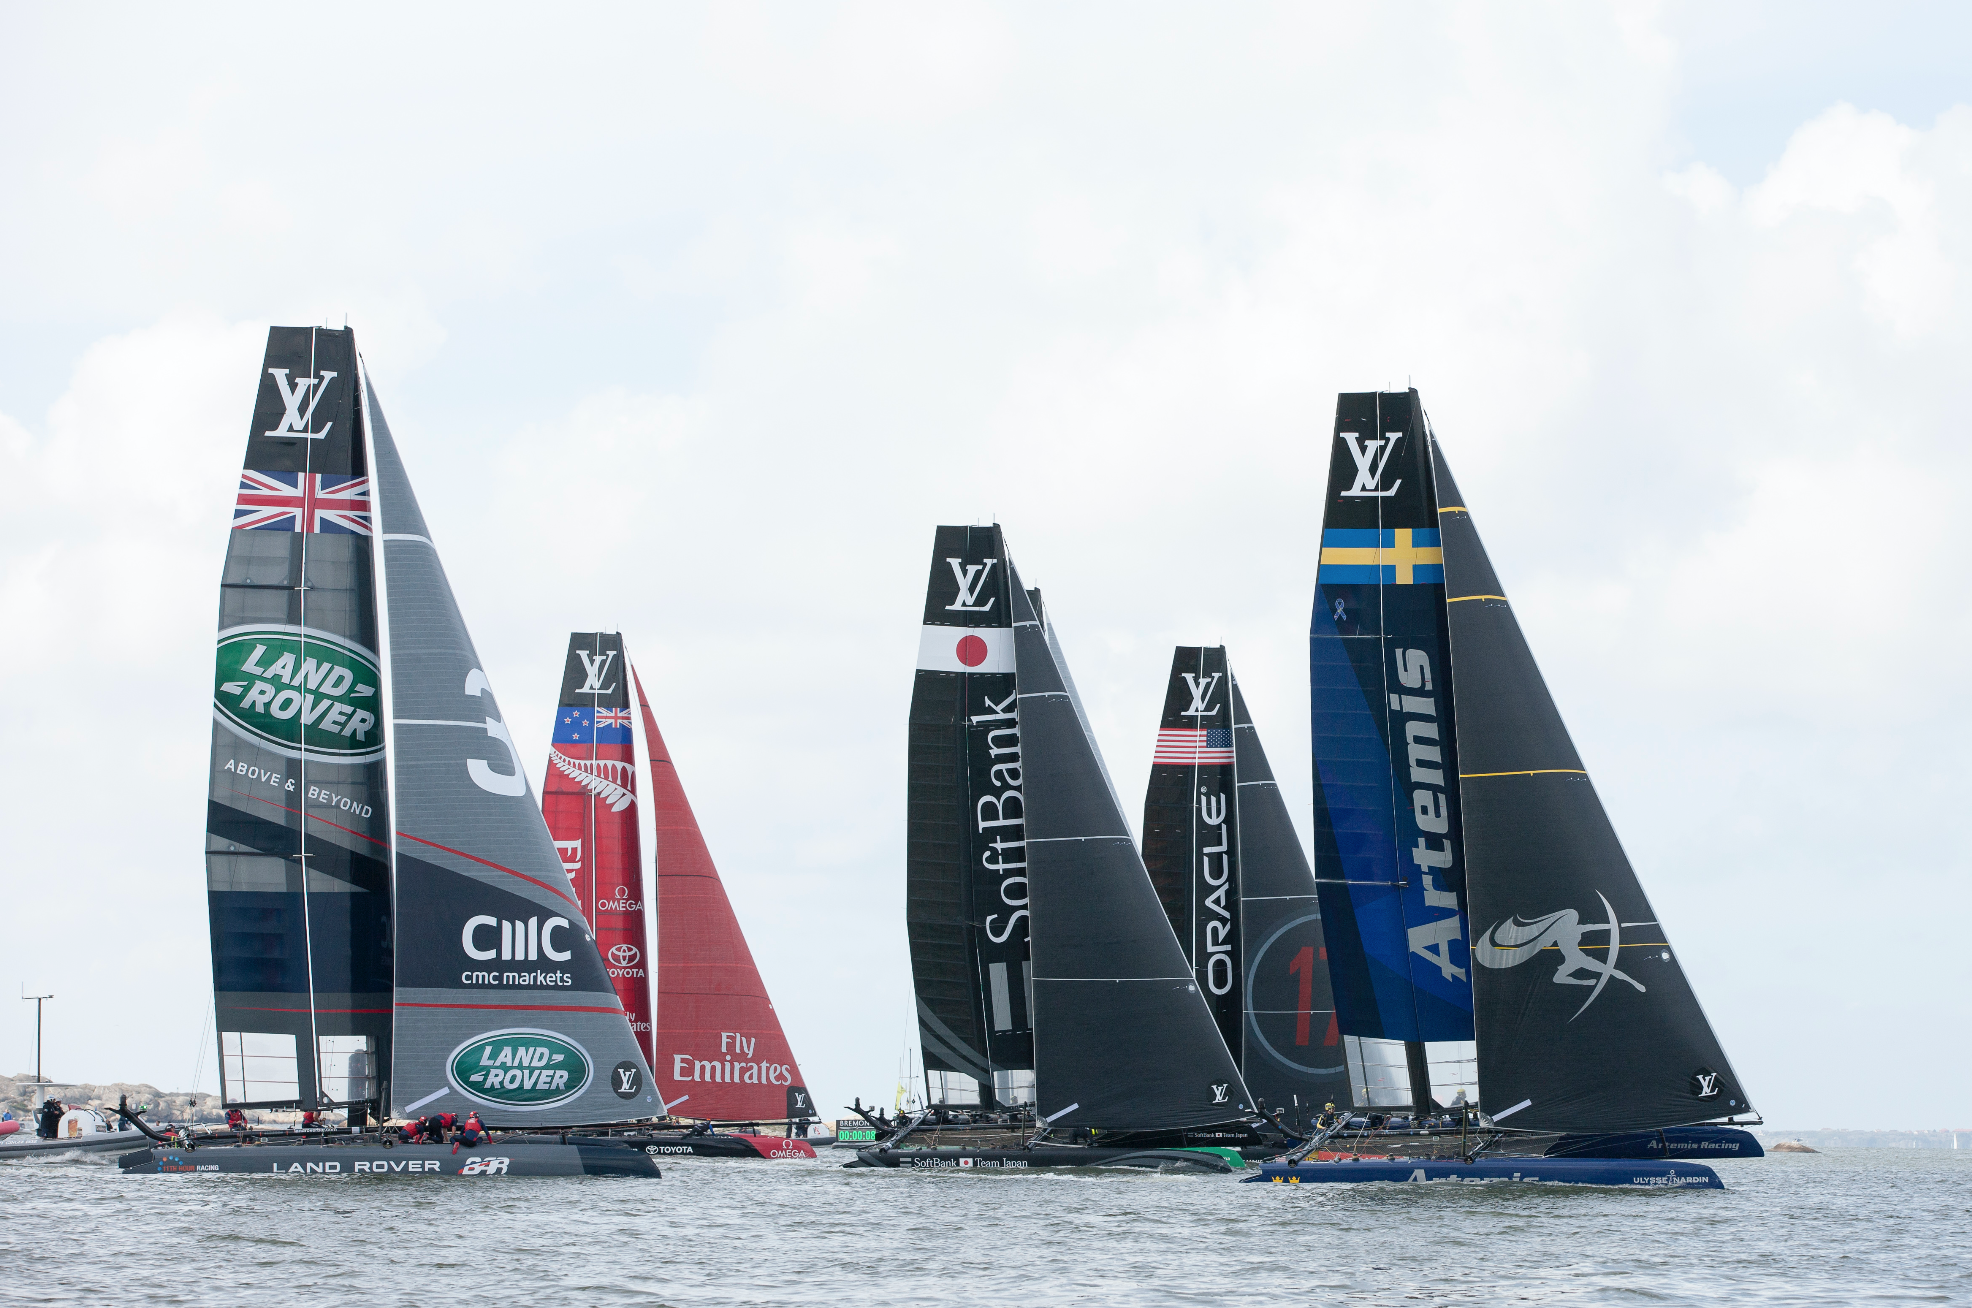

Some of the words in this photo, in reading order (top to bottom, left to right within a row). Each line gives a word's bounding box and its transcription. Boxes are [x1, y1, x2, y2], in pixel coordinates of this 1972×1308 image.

[241, 644, 353, 697] LAND
[239, 680, 375, 742] ROVER
[224, 759, 281, 787] ABOVE
[285, 779, 296, 792] &
[308, 786, 373, 818] BEYOND
[970, 690, 1031, 944] SoftBank
[1390, 647, 1466, 982] Artemis
[598, 900, 643, 911] OMEGA
[462, 971, 499, 984] cmc
[503, 970, 572, 986] markets
[721, 1032, 756, 1058] Fly
[479, 1046, 550, 1067] LAND
[484, 1069, 569, 1090] ROVER
[673, 1054, 792, 1086] Emirates
[770, 1150, 806, 1158] OMEGA
[1700, 1141, 1740, 1151] Racing
[273, 1162, 340, 1173] LAND
[354, 1161, 440, 1172] ROVER
[914, 1158, 957, 1167] SoftBank
[975, 1158, 1000, 1167] Team
[1003, 1158, 1028, 1168] Japan
